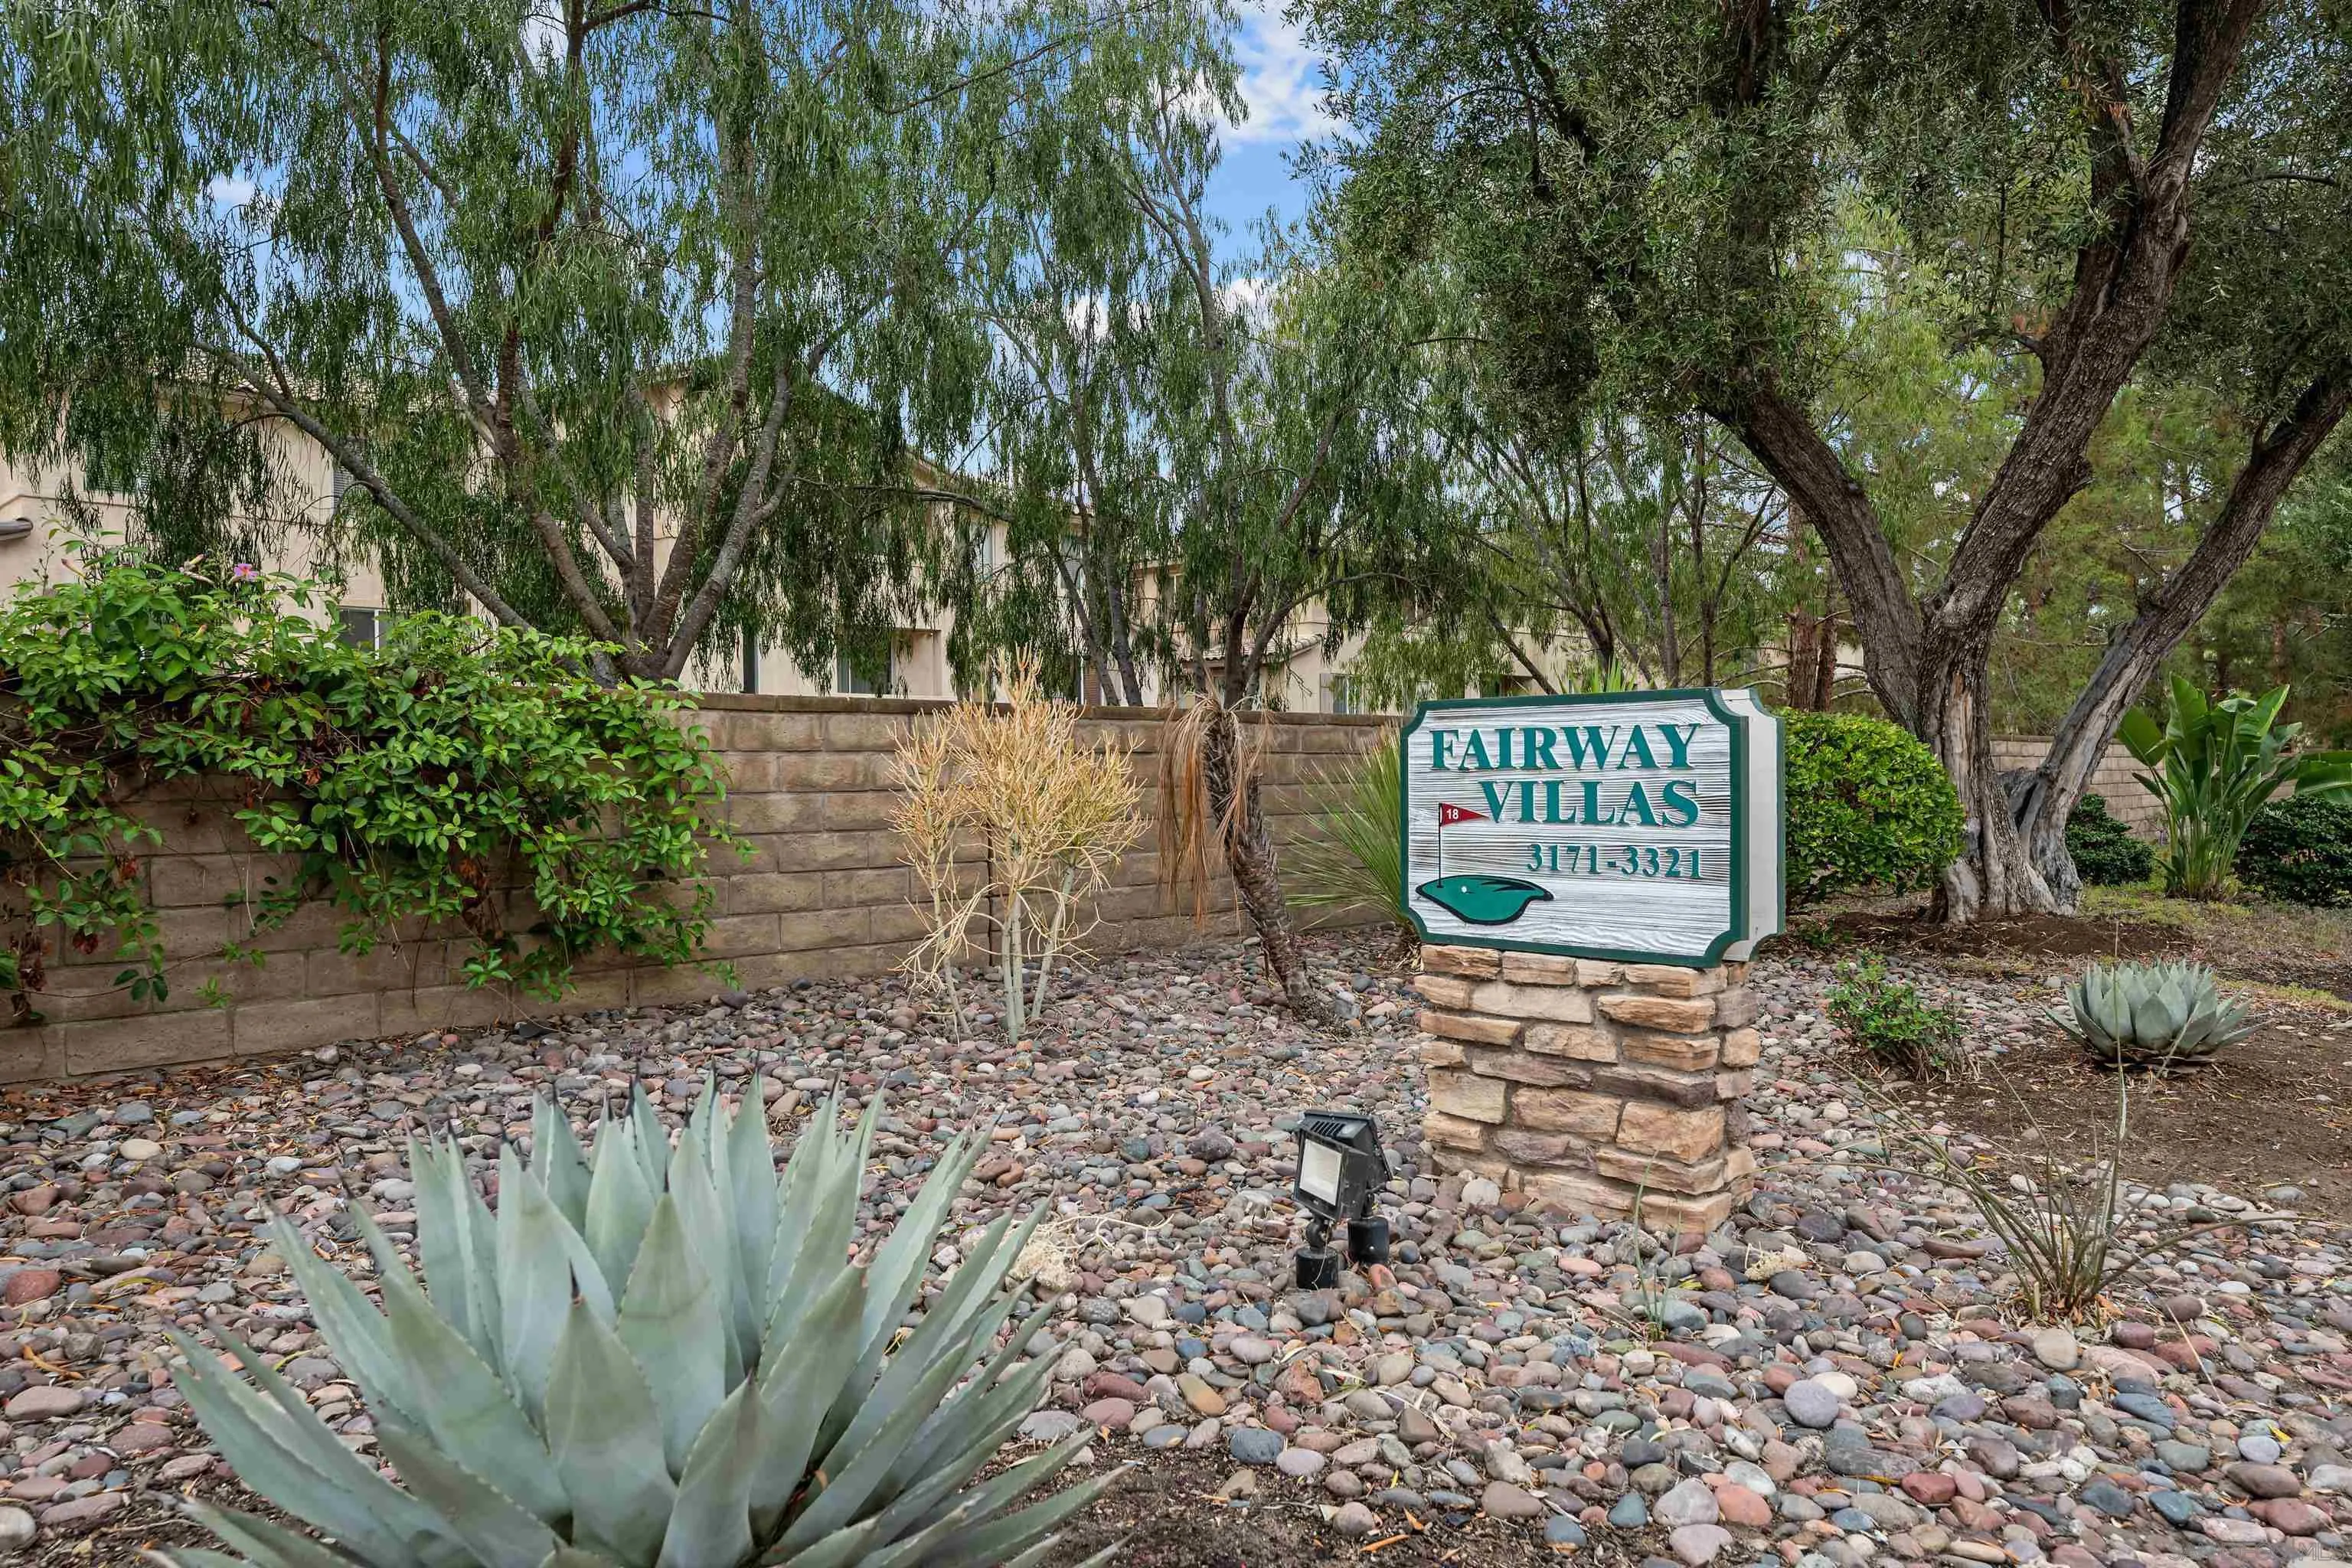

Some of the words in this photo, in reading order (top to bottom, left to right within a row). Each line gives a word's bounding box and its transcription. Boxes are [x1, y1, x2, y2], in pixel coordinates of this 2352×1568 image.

[1429, 723, 1701, 772] FAIRWAY
[1446, 808, 1459, 820] 18
[1478, 779, 1700, 828] VILLAS
[1527, 844, 1704, 880] 3171-3321
